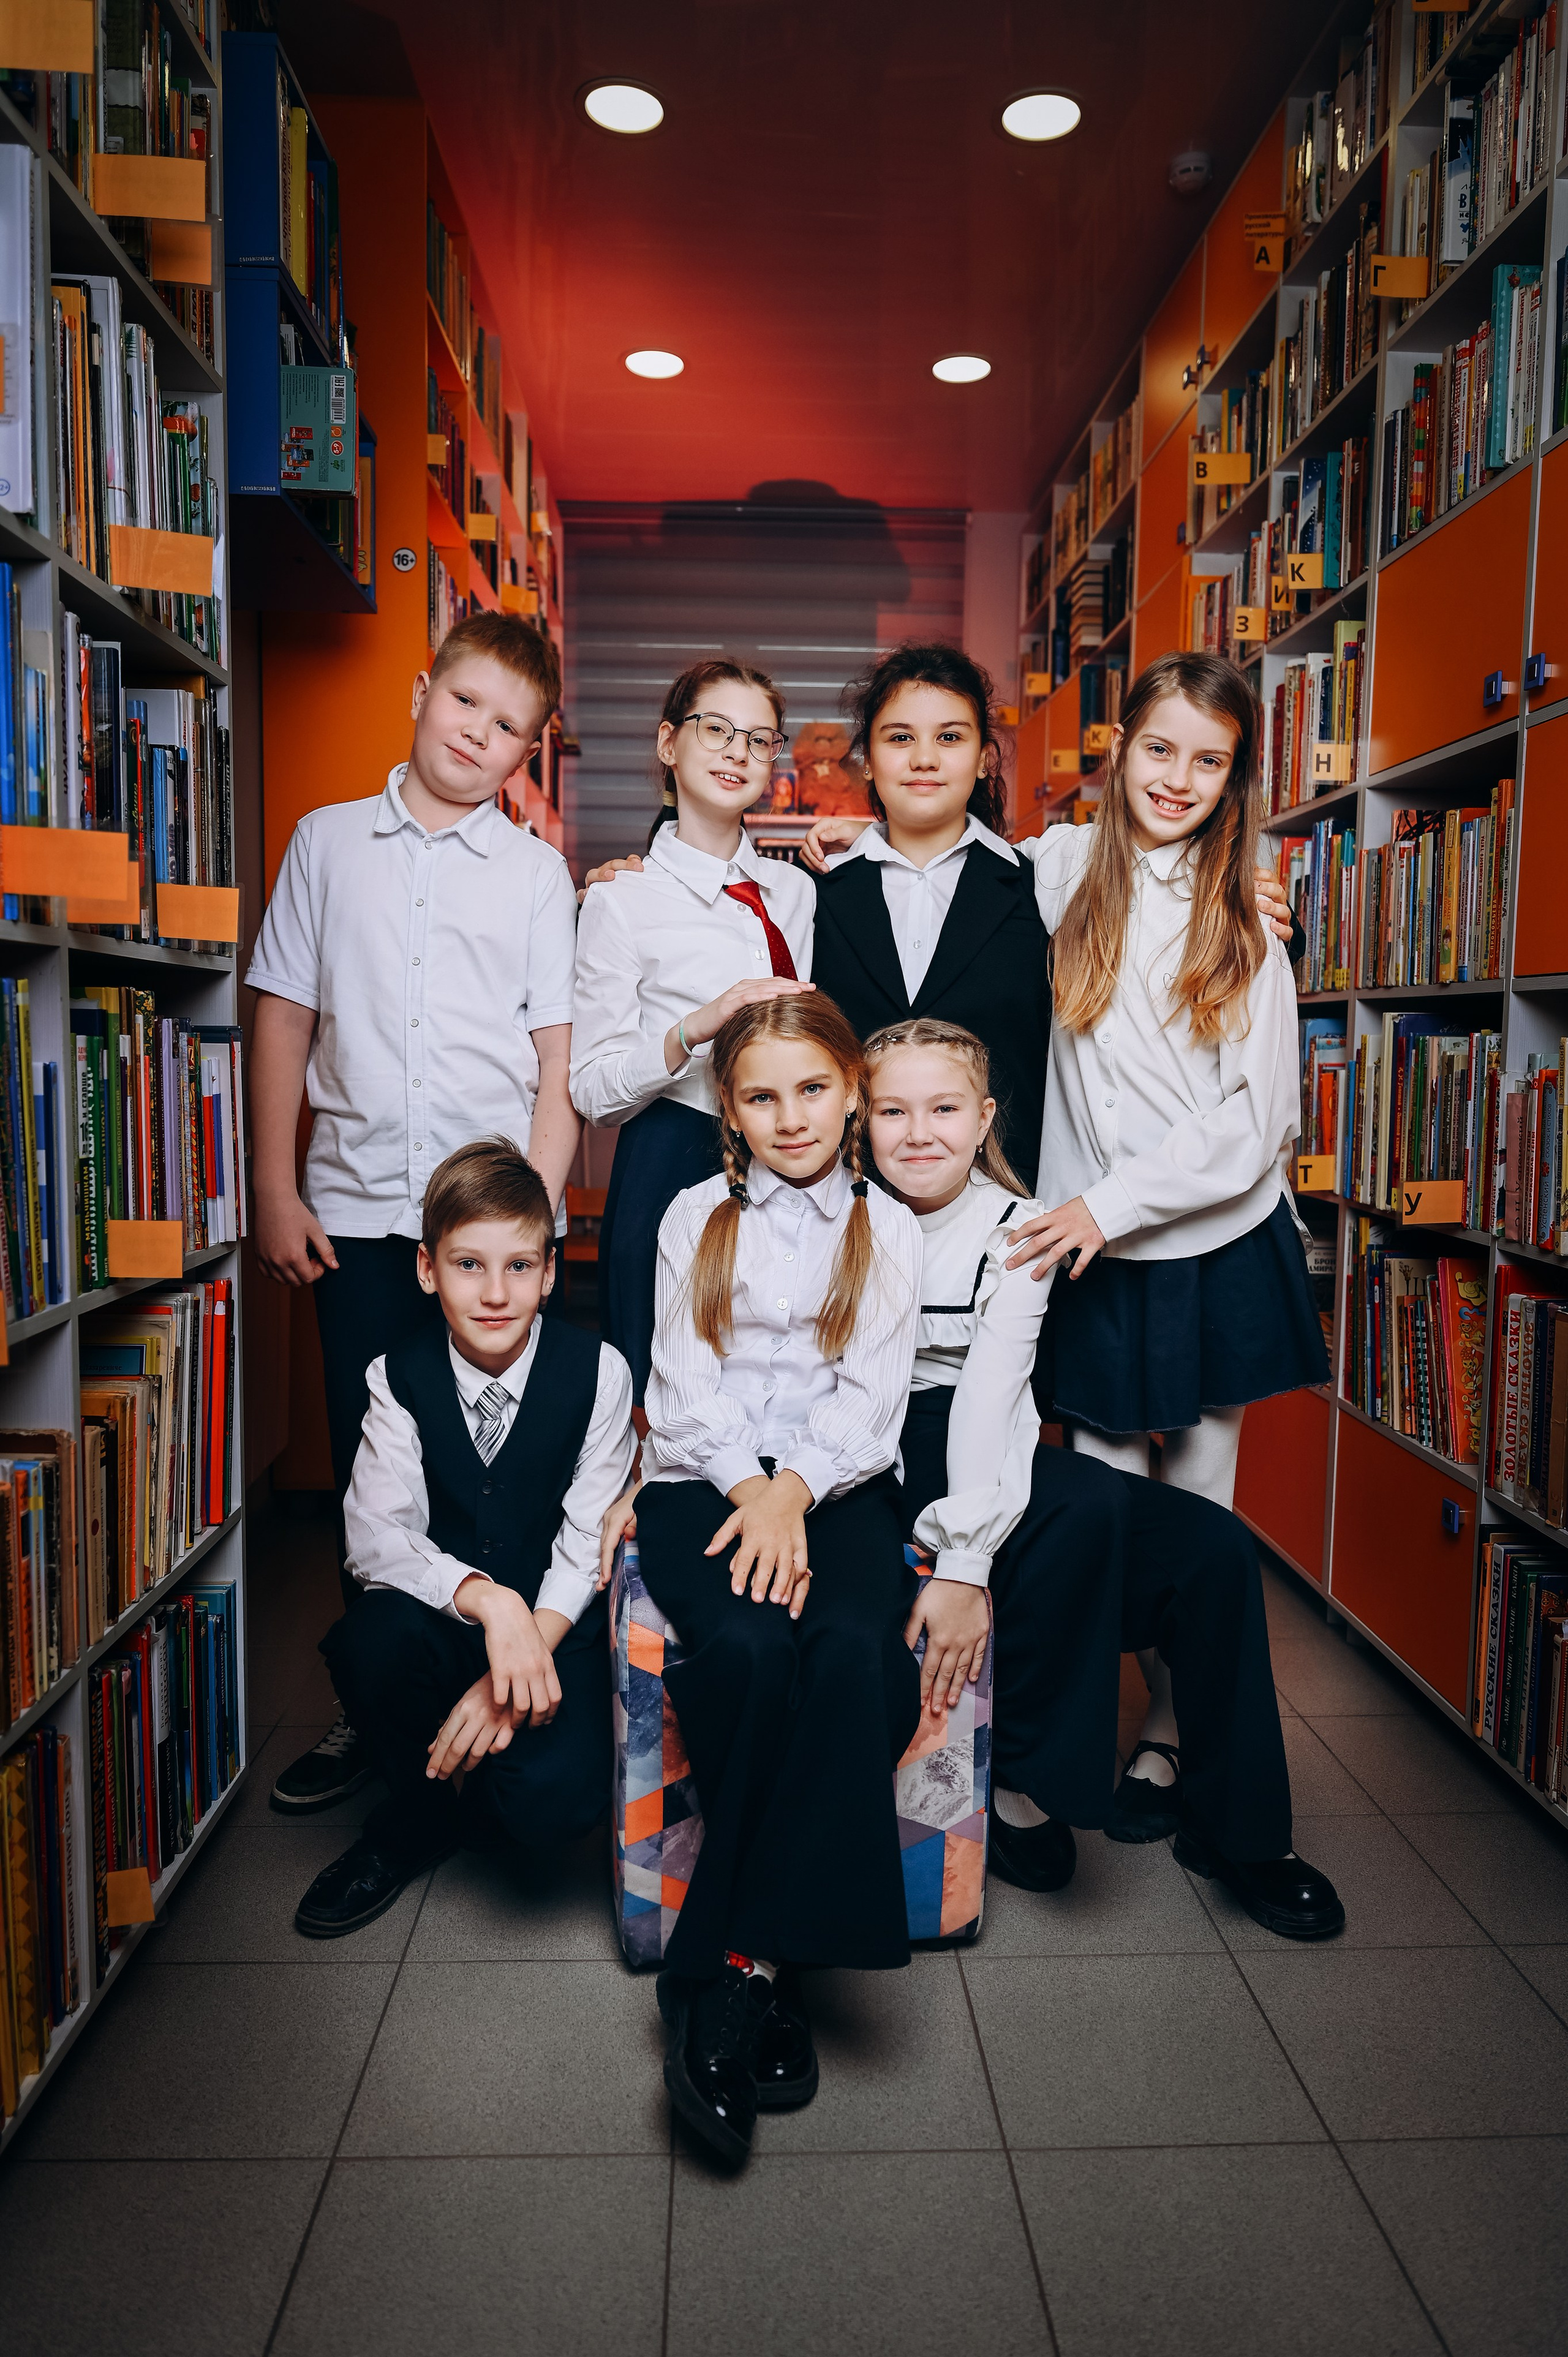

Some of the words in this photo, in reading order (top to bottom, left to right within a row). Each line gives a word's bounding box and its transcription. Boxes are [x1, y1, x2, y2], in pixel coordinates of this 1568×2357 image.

[1256, 246, 1270, 265] А
[1374, 265, 1386, 287] Г
[1196, 461, 1207, 478] В
[394, 552, 415, 567] 16+
[1291, 563, 1306, 582] К
[1275, 585, 1289, 604] И
[1316, 753, 1331, 772] Н
[1299, 1164, 1313, 1183] Т
[1404, 1192, 1422, 1216] У
[32, 1201, 42, 1281] МАЛЬЧИКОВ
[1507, 1310, 1521, 1387] СКАЗКИ
[1520, 1321, 1534, 1411] ЗОЛОТЫЕ
[1504, 1391, 1518, 1483] ЗОЛОТЫЕ
[1517, 1414, 1529, 1490] СКАЗКИ
[1484, 1643, 1496, 1731] РУССКИЕ
[1490, 1560, 1501, 1640] СКАЗКИ
[1520, 1646, 1529, 1711] КАЛЕВАЛА
[92, 1788, 104, 1884] РЕКОРДОВ
